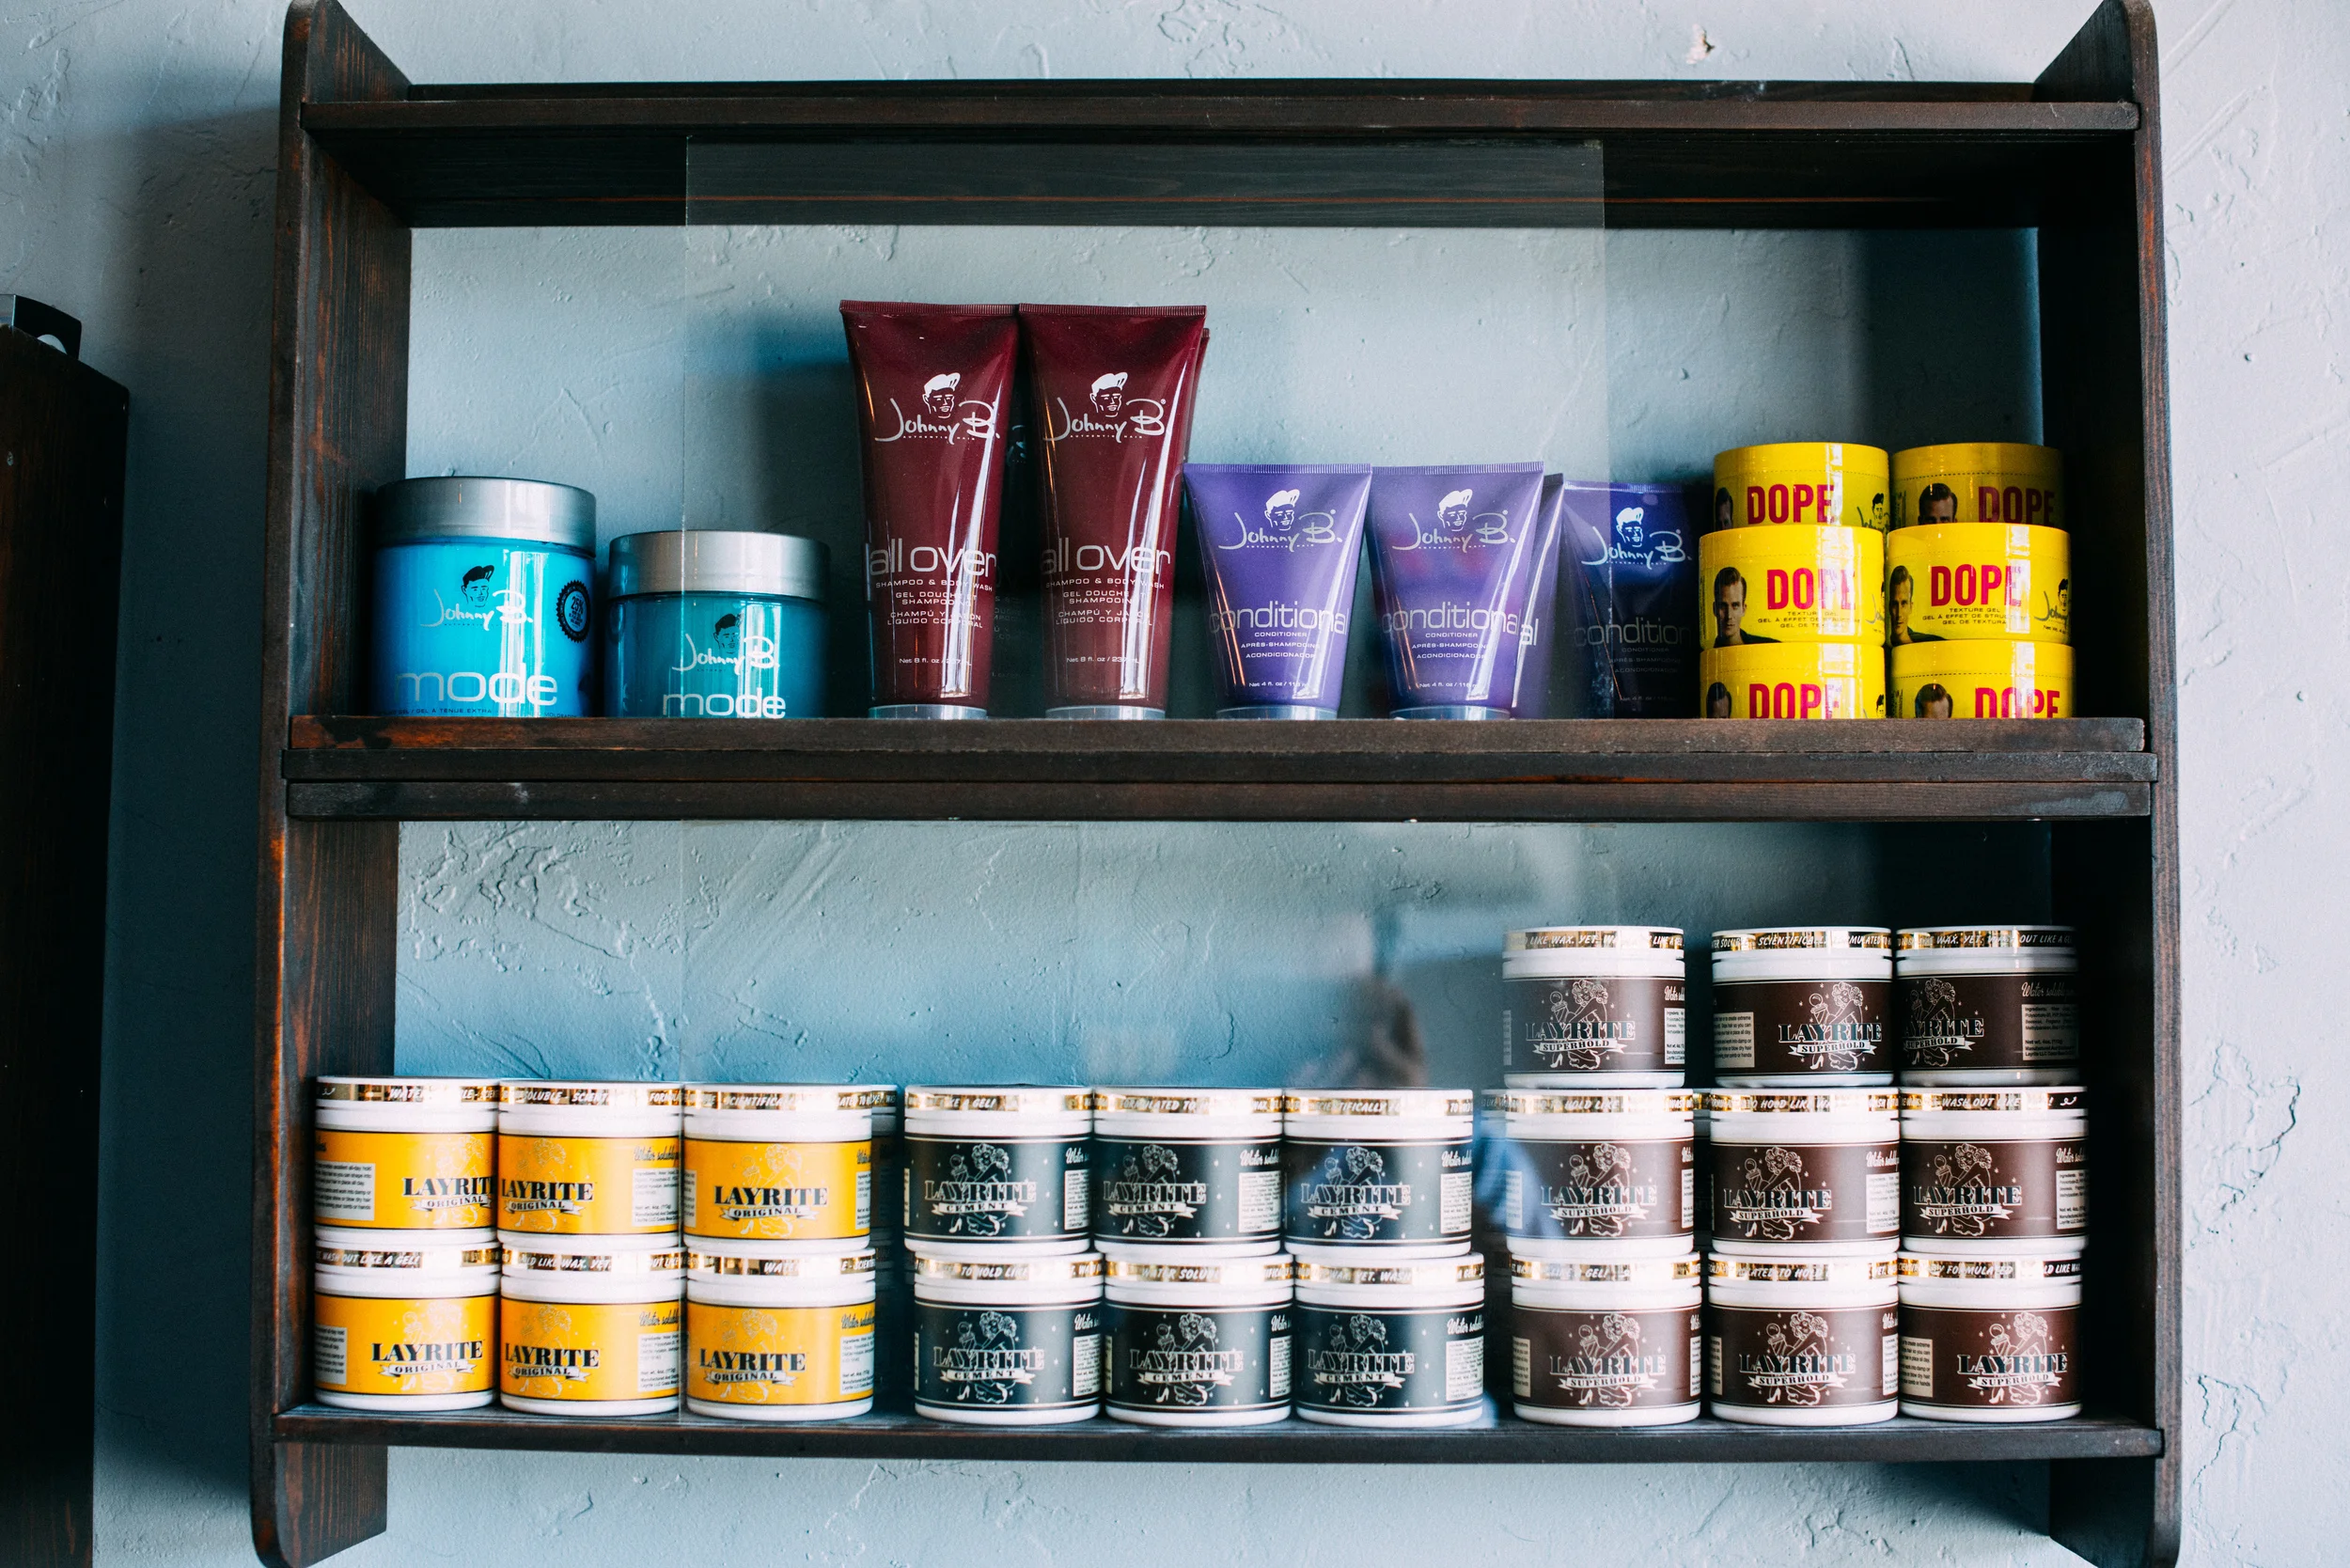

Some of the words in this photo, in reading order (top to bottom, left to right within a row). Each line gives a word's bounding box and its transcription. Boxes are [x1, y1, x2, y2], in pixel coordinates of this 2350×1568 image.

[874, 398, 961, 445] Johnny
[1043, 397, 1127, 443] Johnny
[1747, 484, 1835, 525] DOPE
[1979, 486, 2055, 526] DOPE
[1218, 512, 1300, 552] Johnny
[1392, 512, 1472, 553] Johnny
[870, 538, 902, 575] all
[910, 546, 997, 577] over
[1041, 537, 1069, 574] all
[1076, 545, 1170, 574] over
[1582, 525, 1654, 570] Johnny
[876, 579, 923, 588] SHAMPOO
[973, 582, 993, 591] WASH
[1046, 579, 1089, 588] SHAMPOO
[1931, 564, 2022, 607] DOPE
[420, 588, 494, 631] Johnny
[1209, 601, 1349, 635] conditional
[1382, 602, 1522, 635] conditional
[672, 634, 745, 675] Johnny
[394, 663, 558, 707] mode
[663, 687, 786, 719] mode
[1936, 935, 1959, 945] WAX.
[2019, 934, 2037, 943] OUT
[2040, 934, 2057, 943] LIKE
[2022, 981, 2044, 996] Water
[1526, 1021, 1636, 1041] LAYRITE
[1778, 1023, 1882, 1043] LAYRITE
[1543, 1040, 1609, 1051] SUPERHOLD
[1802, 1042, 1865, 1053] SUPERHOLD
[1906, 1038, 1958, 1048] SUPERHOLD
[1565, 1100, 1590, 1110] HOLD
[1942, 1096, 1968, 1106] WASH
[1974, 1096, 1995, 1105] OUT
[502, 1178, 593, 1201] LAYRITE
[714, 1185, 827, 1206] LAYRITE
[924, 1180, 1037, 1202] LAYRITE
[1104, 1181, 1207, 1204] LAYRITE
[1301, 1184, 1411, 1206] LAYRITE
[1541, 1185, 1657, 1206] LAYRITE
[1724, 1188, 1832, 1210] LAYRITE
[1914, 1185, 2022, 1205] LAYRITE
[427, 1196, 484, 1208] ORIGINAL
[510, 1200, 565, 1211] ORIGINAL
[733, 1207, 801, 1217] ORIGINAL
[947, 1202, 1008, 1212] CEMENT
[1120, 1204, 1176, 1213] CEMENT
[1322, 1206, 1382, 1215] CEMENT
[1561, 1206, 1632, 1216] SUPERHOLD
[1929, 1206, 1994, 1215] SUPERHOLD
[1739, 1209, 1804, 1219] SUPERHOLD
[342, 1253, 358, 1262] OUT
[384, 1255, 393, 1264] A
[395, 1255, 421, 1265] GEL!
[562, 1258, 588, 1269] WAX.
[2056, 1263, 2071, 1273] LIKE
[1585, 1268, 1608, 1278] GEL!
[371, 1340, 483, 1361] LAYRITE
[505, 1342, 600, 1368] LAYRITE
[699, 1348, 806, 1372] LAYRITE
[933, 1346, 1045, 1371] LAYRITE
[1130, 1349, 1244, 1372] LAYRITE
[395, 1361, 461, 1373] ORIGINAL
[515, 1367, 570, 1376] ORIGINAL
[1308, 1349, 1415, 1374] LAYRITE
[1549, 1355, 1667, 1376] LAYRITE
[1739, 1354, 1856, 1374] LAYRITE
[1957, 1352, 2067, 1375] LAYRITE
[714, 1371, 777, 1382] ORIGINAL
[954, 1370, 1015, 1379] CEMENT
[1152, 1372, 1215, 1381] CEMENT
[1326, 1373, 1386, 1382] CEMENT
[1571, 1376, 1641, 1387] SUPERHOLD
[1759, 1374, 1829, 1385] SUPERHOLD
[1981, 1374, 2049, 1386] SUPERHOLD
